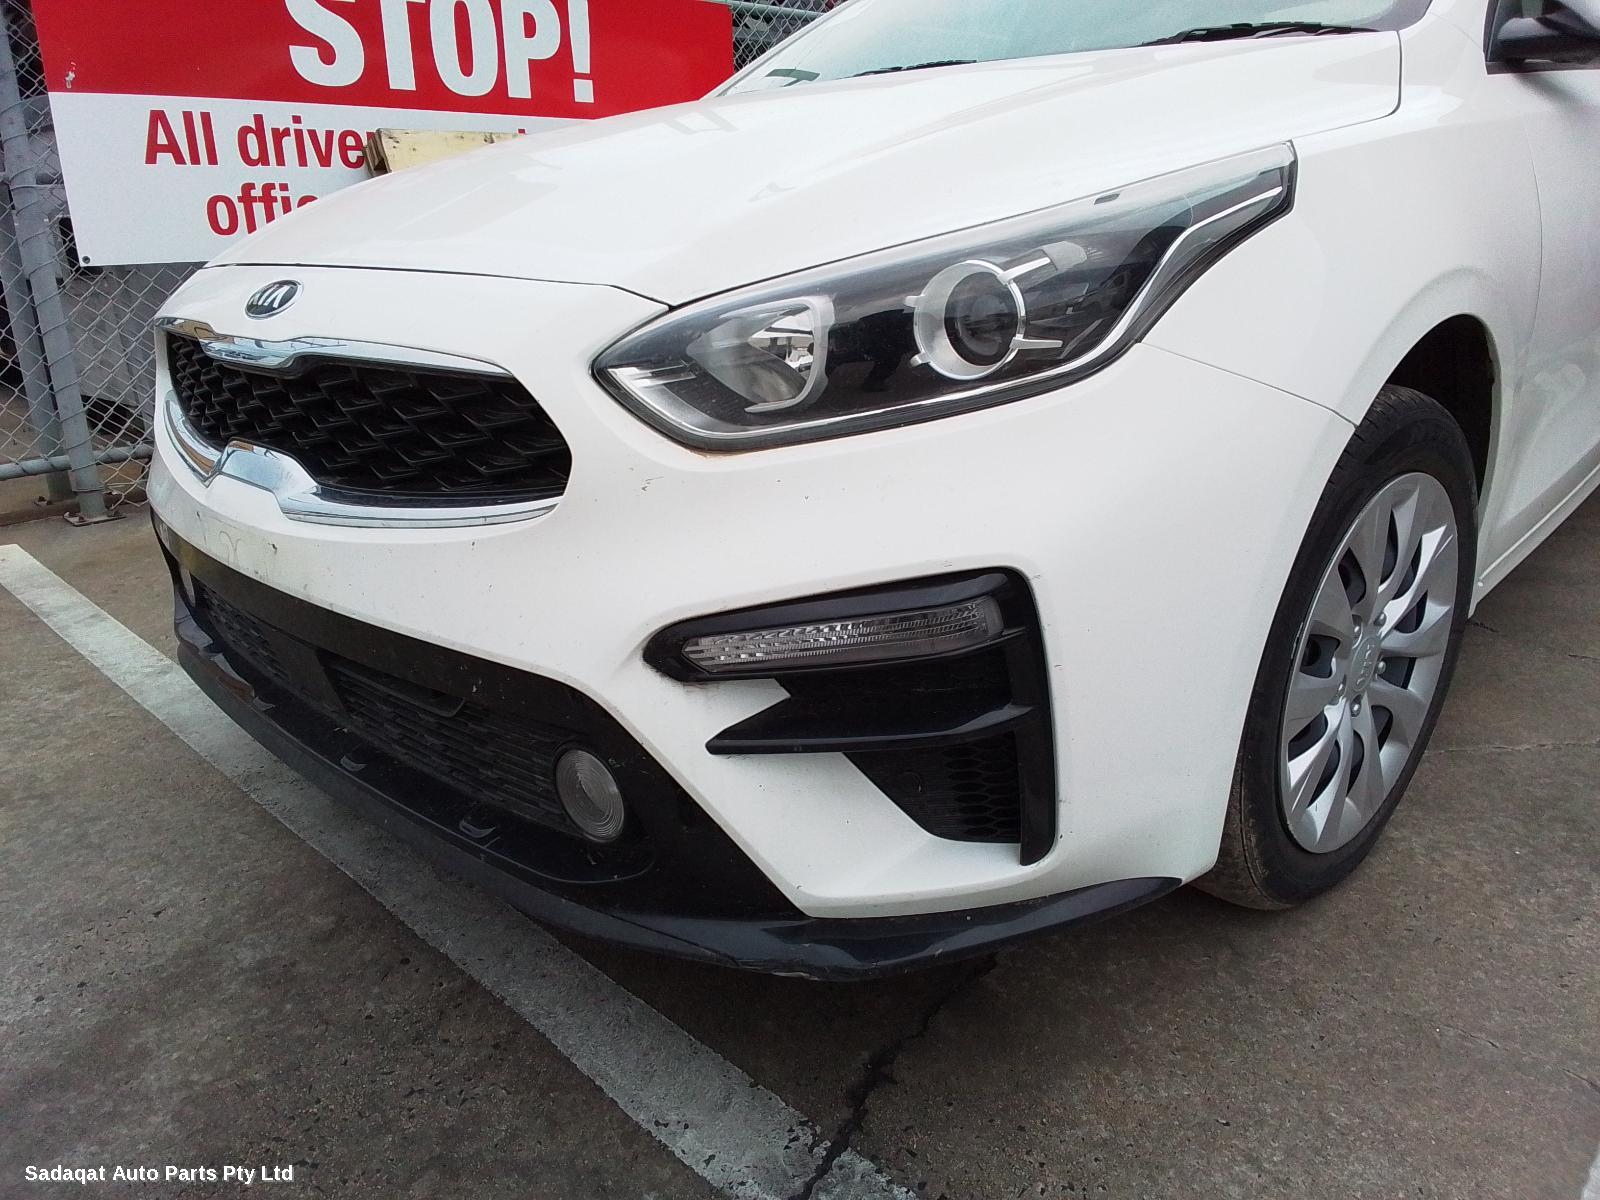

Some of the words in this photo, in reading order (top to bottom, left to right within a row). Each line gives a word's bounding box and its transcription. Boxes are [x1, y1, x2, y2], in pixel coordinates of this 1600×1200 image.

[288, 0, 595, 103] STOP!
[145, 109, 218, 166] All
[237, 113, 376, 170] drive
